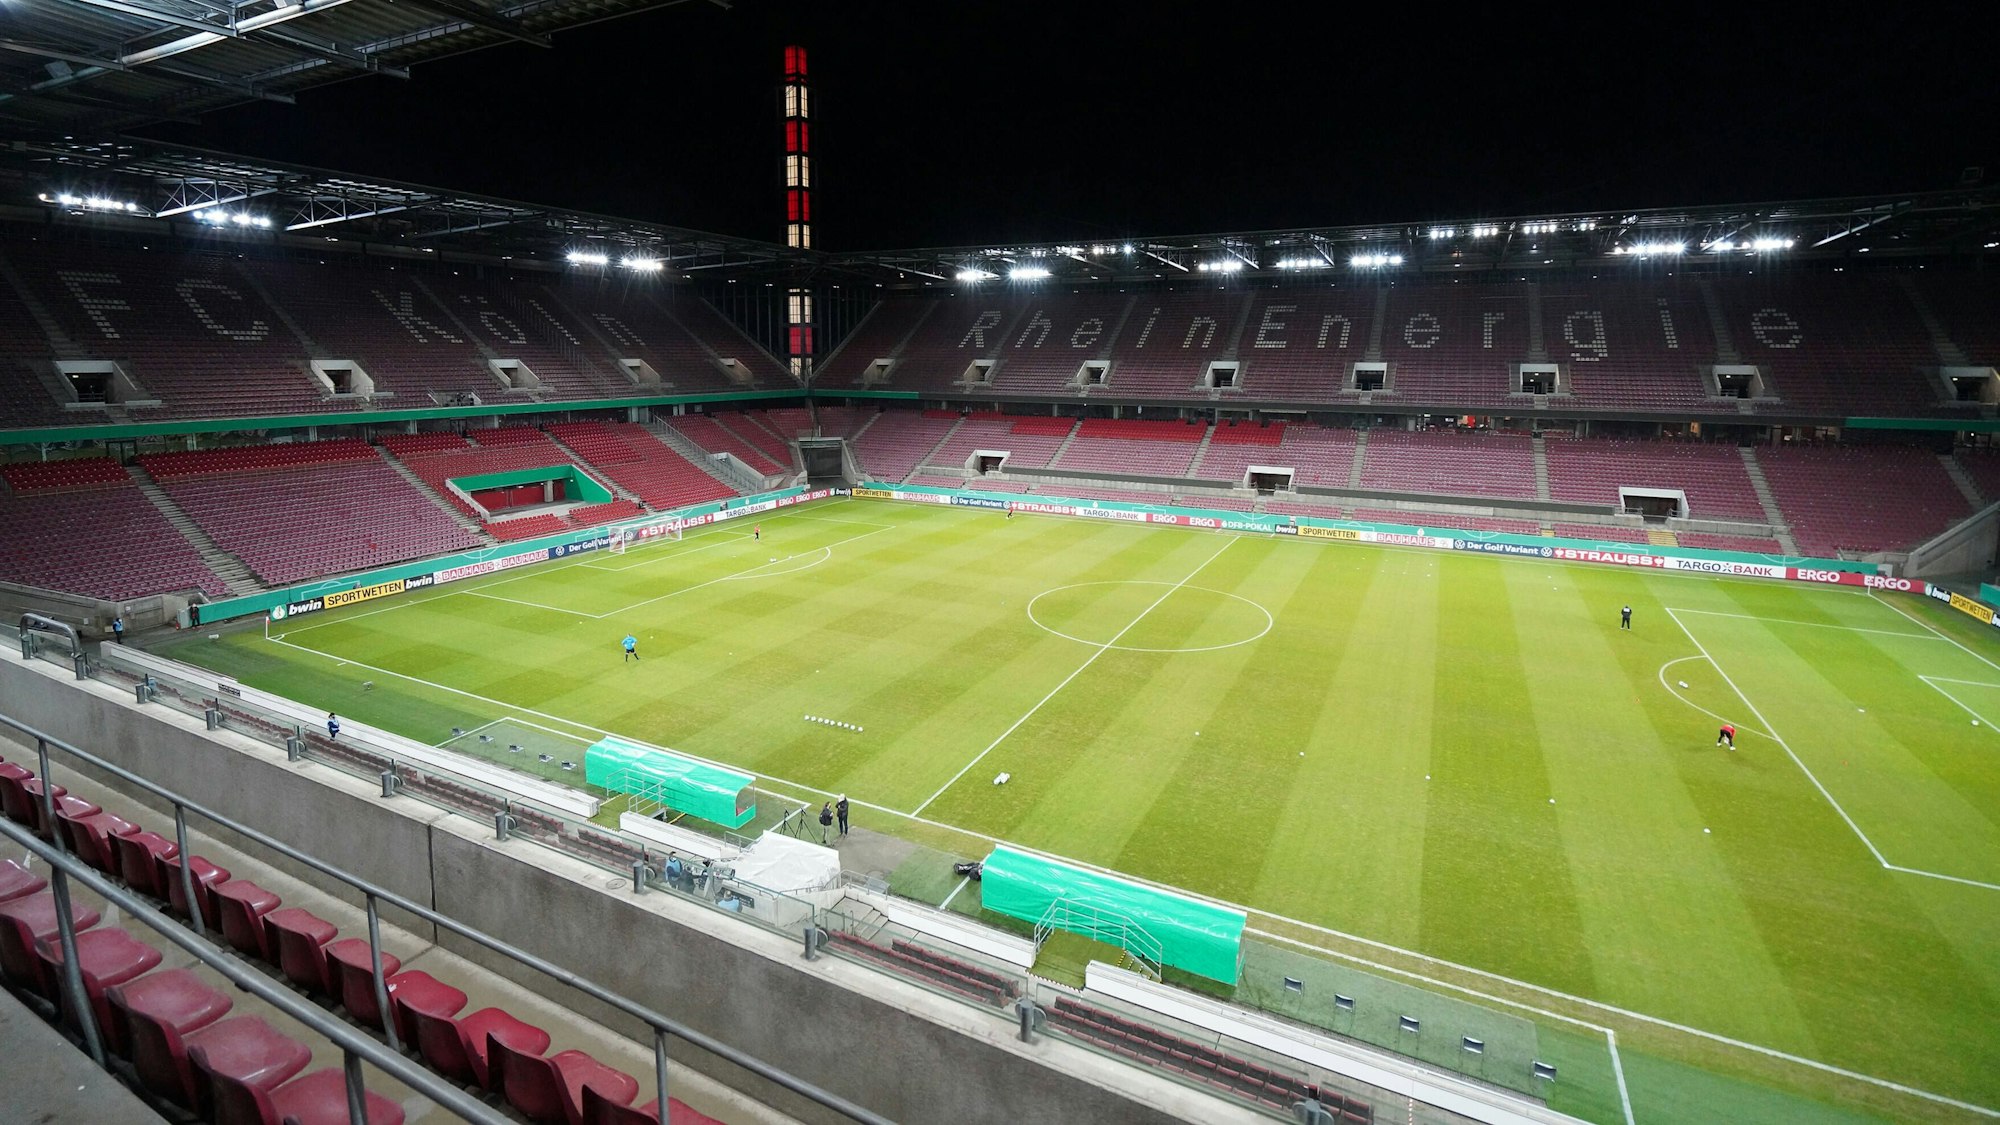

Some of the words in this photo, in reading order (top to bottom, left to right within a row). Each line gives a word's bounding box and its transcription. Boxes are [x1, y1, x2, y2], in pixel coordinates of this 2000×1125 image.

[57, 270, 270, 341] FC
[796, 494, 810, 503] ERGO
[812, 490, 827, 499] ERGO
[855, 489, 892, 497] SPORTWETTEN
[778, 498, 794, 507] ERGO
[969, 498, 981, 506] Golf
[982, 499, 1002, 507] Variant
[649, 515, 706, 535] STRAUSS
[1152, 514, 1178, 524] ERGO
[1189, 517, 1215, 527] ERGO
[1228, 521, 1272, 531] DFB-POKAL
[1276, 525, 1297, 534] bwin
[1302, 527, 1356, 539] SPORTWETTEN
[1376, 532, 1436, 547] BAUHAUS
[569, 544, 582, 553] Der
[1467, 541, 1483, 550] Der
[1484, 542, 1504, 551] Golf
[1505, 544, 1539, 555] Variant
[1565, 549, 1654, 566] STRAUSS
[442, 562, 495, 581] BAUHAUS
[501, 550, 549, 567] BAUHAUS
[405, 575, 433, 590] bwin
[1797, 569, 1840, 583] ERGO
[1863, 574, 1911, 591] ERGO
[328, 582, 402, 606] SPORTWETTEN
[289, 599, 323, 616] bwin
[1951, 595, 1990, 621] SPORTWETTEN
